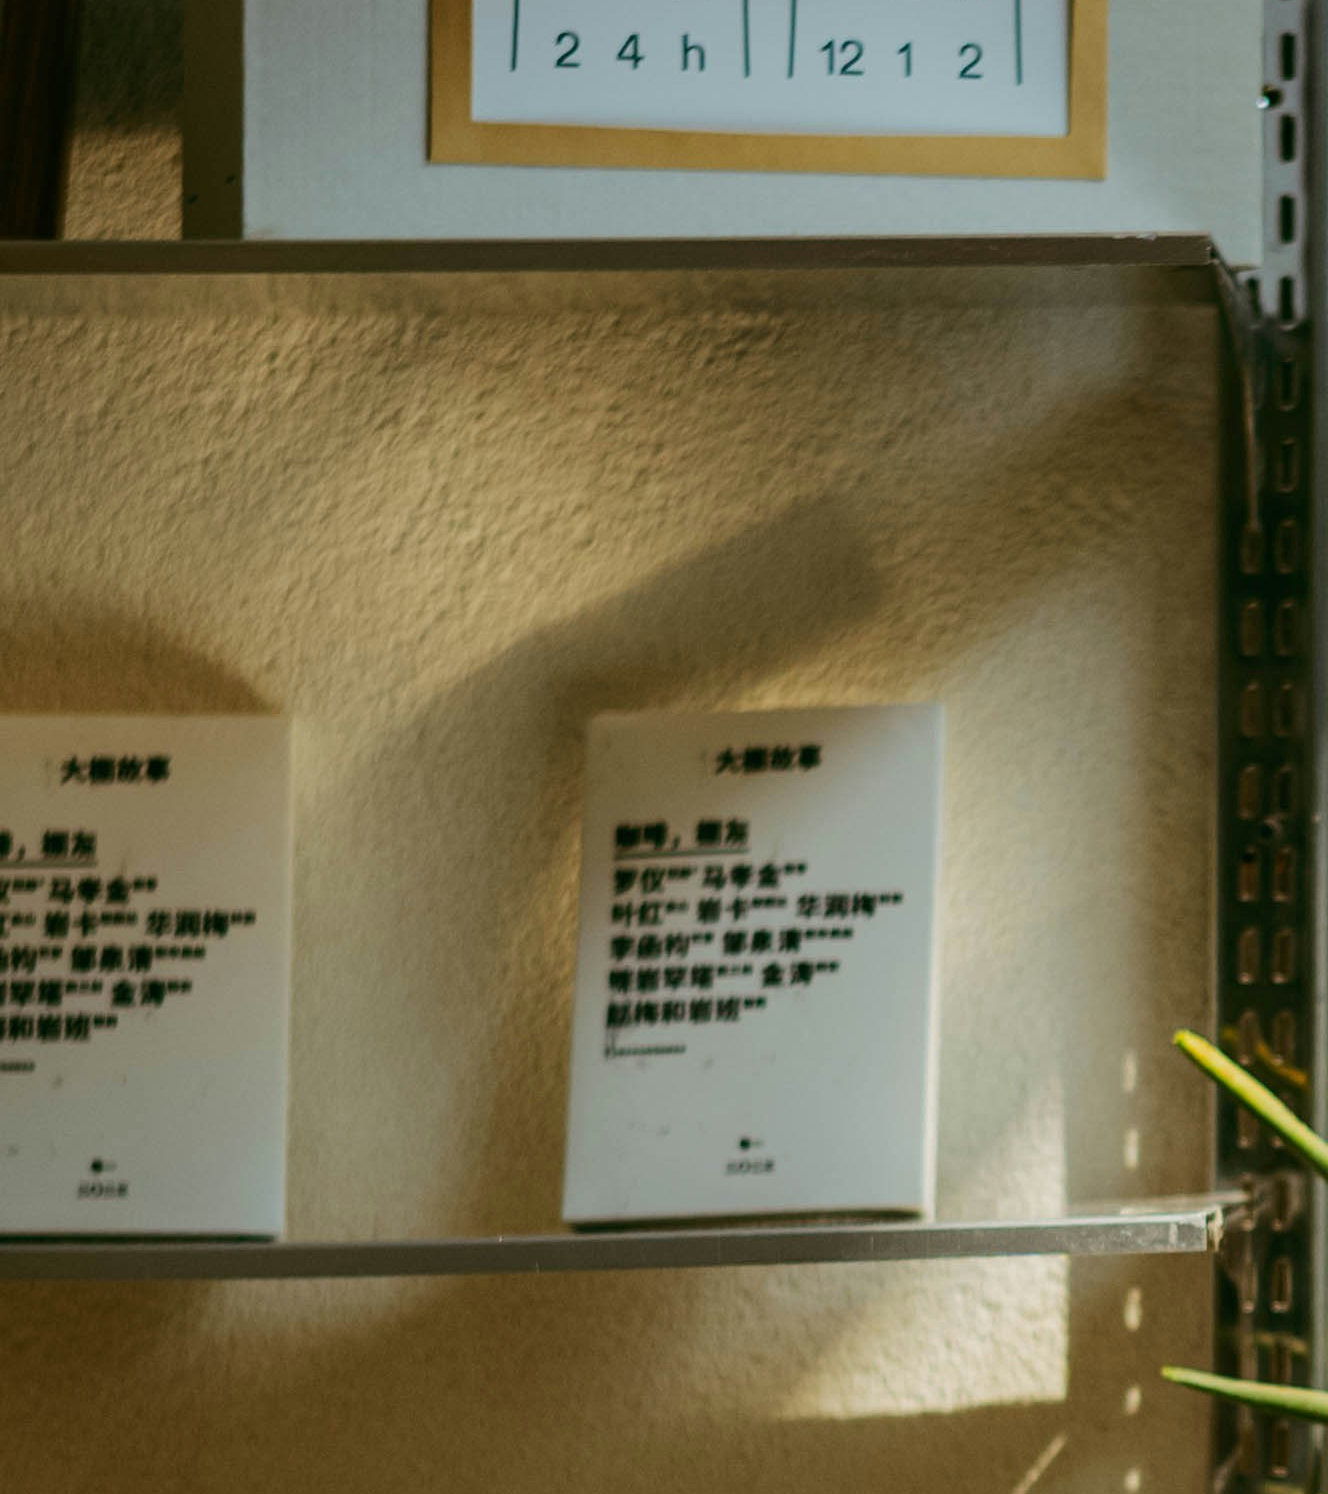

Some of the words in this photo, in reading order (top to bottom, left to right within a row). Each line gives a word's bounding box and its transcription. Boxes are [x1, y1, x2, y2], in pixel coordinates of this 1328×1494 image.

[820, 39, 865, 77] 12
[896, 42, 914, 79] 1
[957, 42, 983, 79] 2
